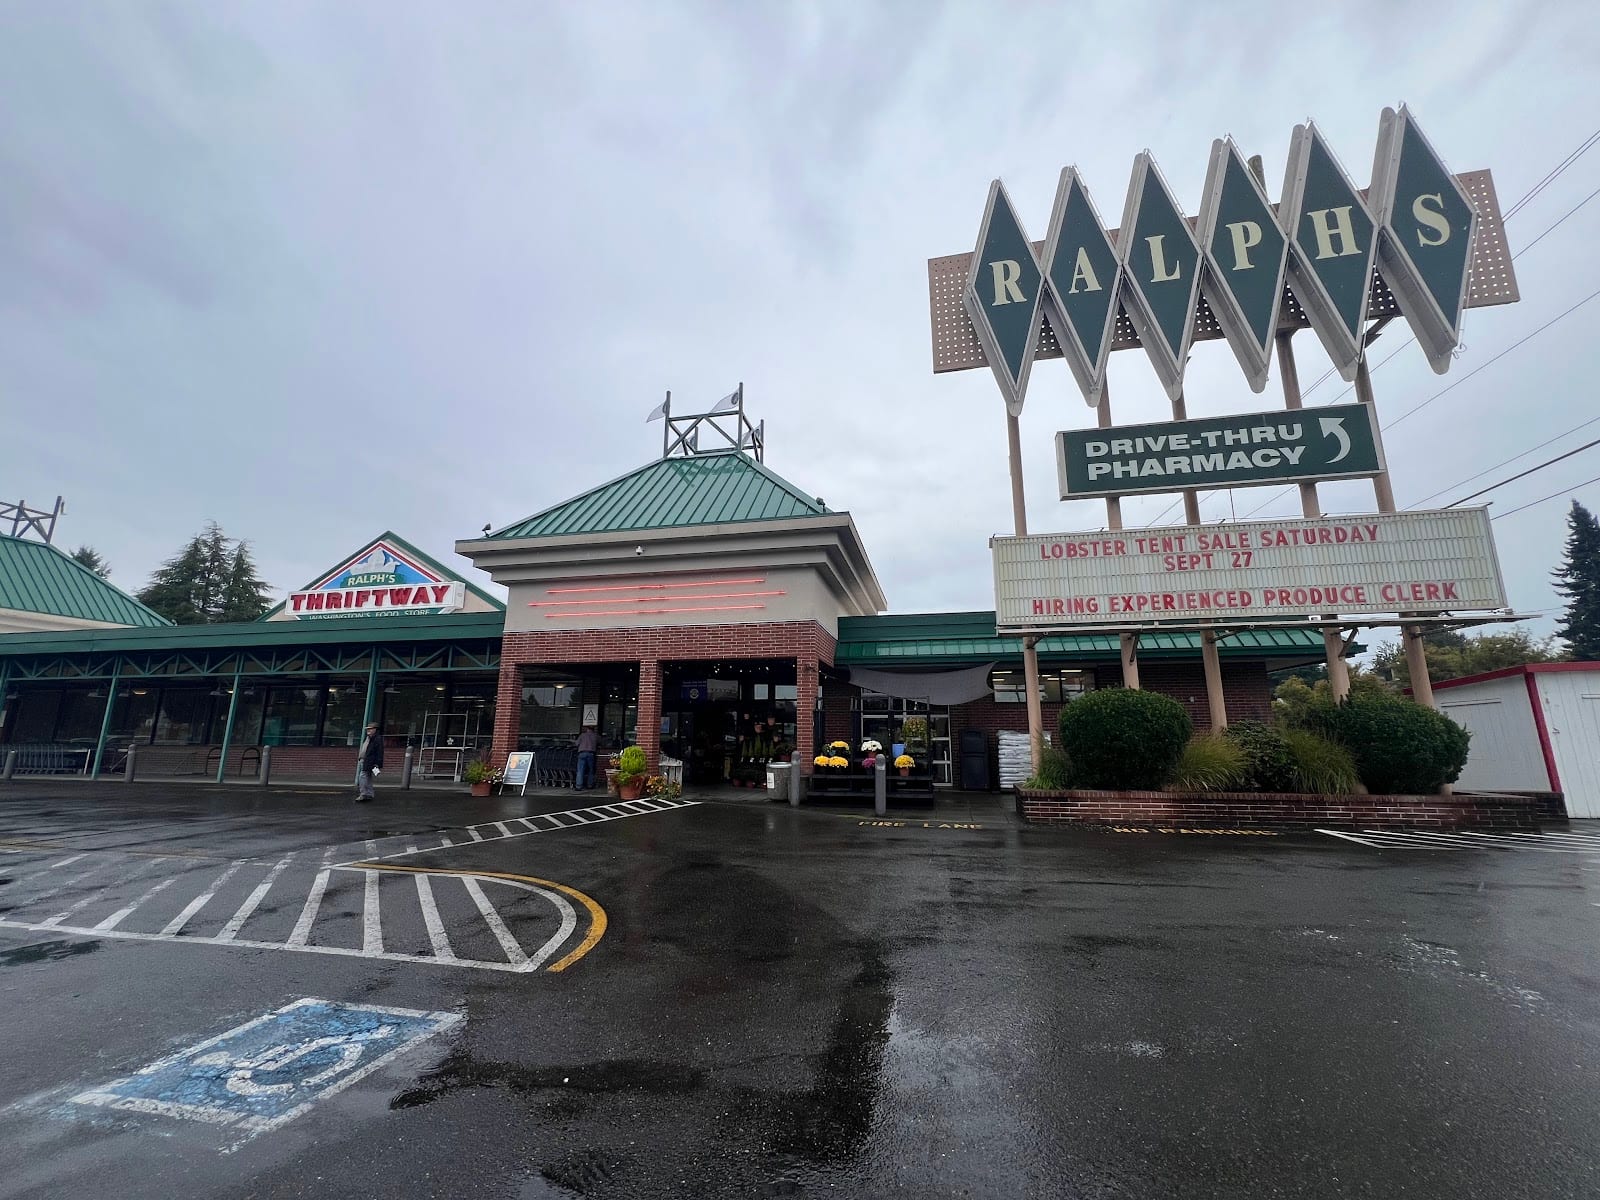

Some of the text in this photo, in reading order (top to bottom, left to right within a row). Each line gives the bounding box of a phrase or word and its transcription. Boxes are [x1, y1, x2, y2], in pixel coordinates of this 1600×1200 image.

[989, 192, 1451, 307] RALPHS
[1085, 423, 1304, 458] DRIVE-THRU
[1087, 446, 1307, 481] PHARMACY
[1041, 524, 1379, 560] LOBSTER TENT SALE SATURDAY
[1165, 551, 1253, 572] SEPT 27
[347, 574, 396, 586] RALPH'S
[290, 585, 451, 611] THRIFTWAY
[1032, 582, 1459, 616] HIRING EXPERIENCED PRODUCE CLERK
